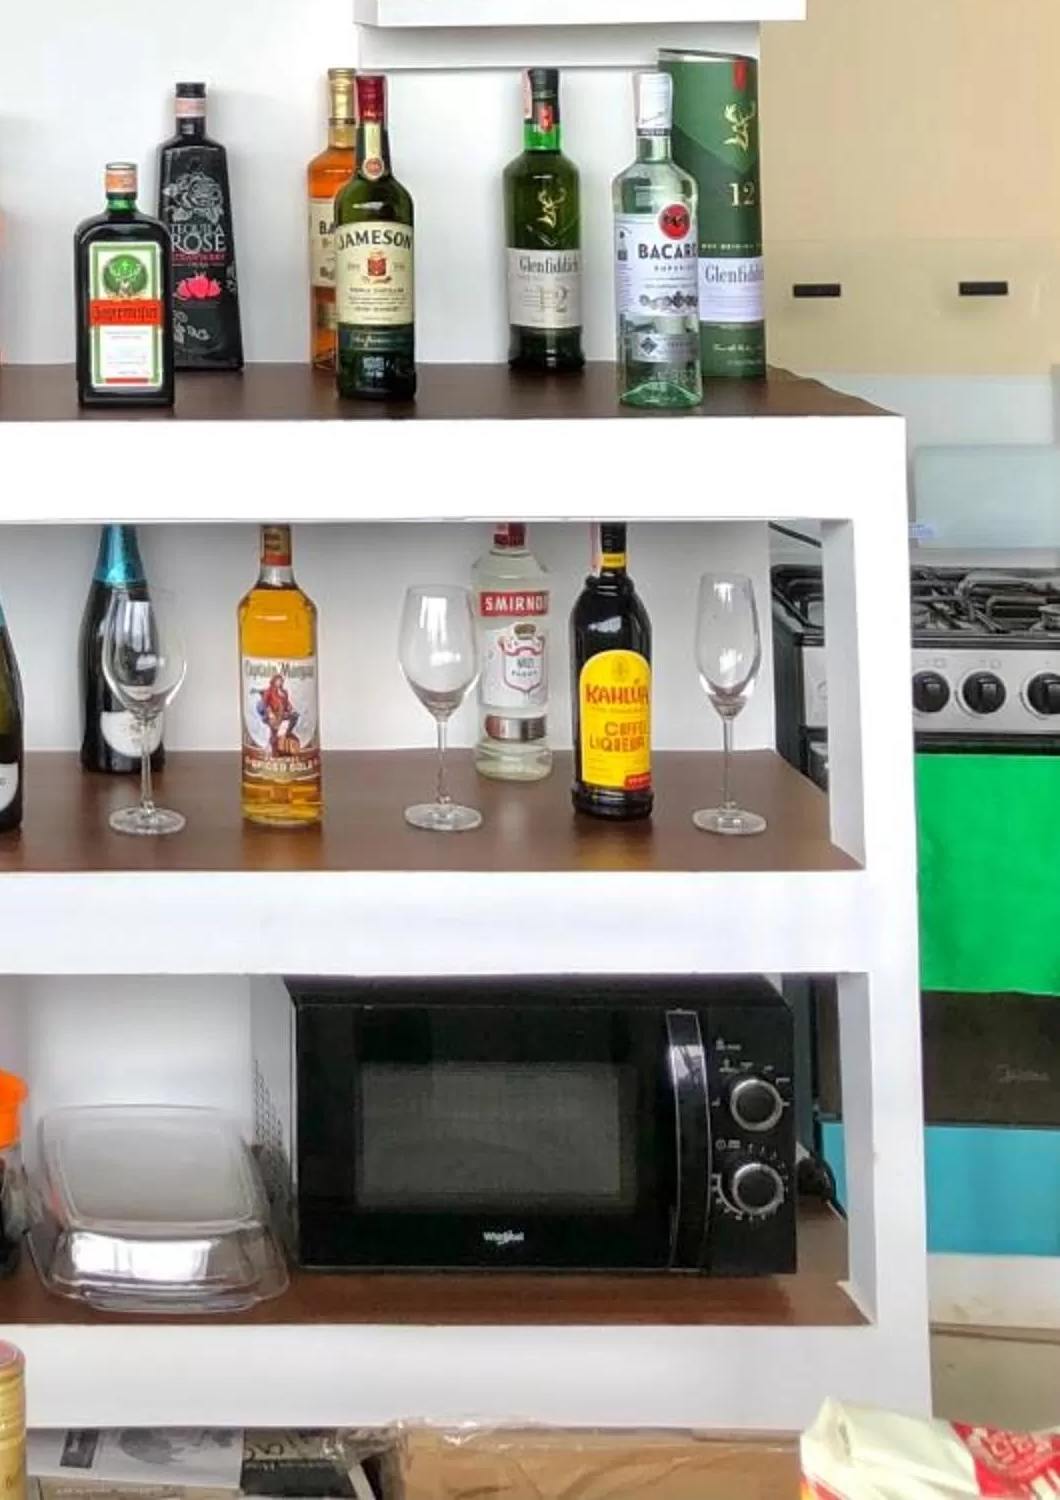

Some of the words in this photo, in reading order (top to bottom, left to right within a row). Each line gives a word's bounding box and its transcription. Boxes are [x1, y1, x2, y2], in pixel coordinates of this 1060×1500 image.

[728, 183, 756, 206] 12
[171, 223, 225, 237] TEQUILA
[339, 229, 412, 251] JAMESON
[171, 233, 227, 255] ROSE
